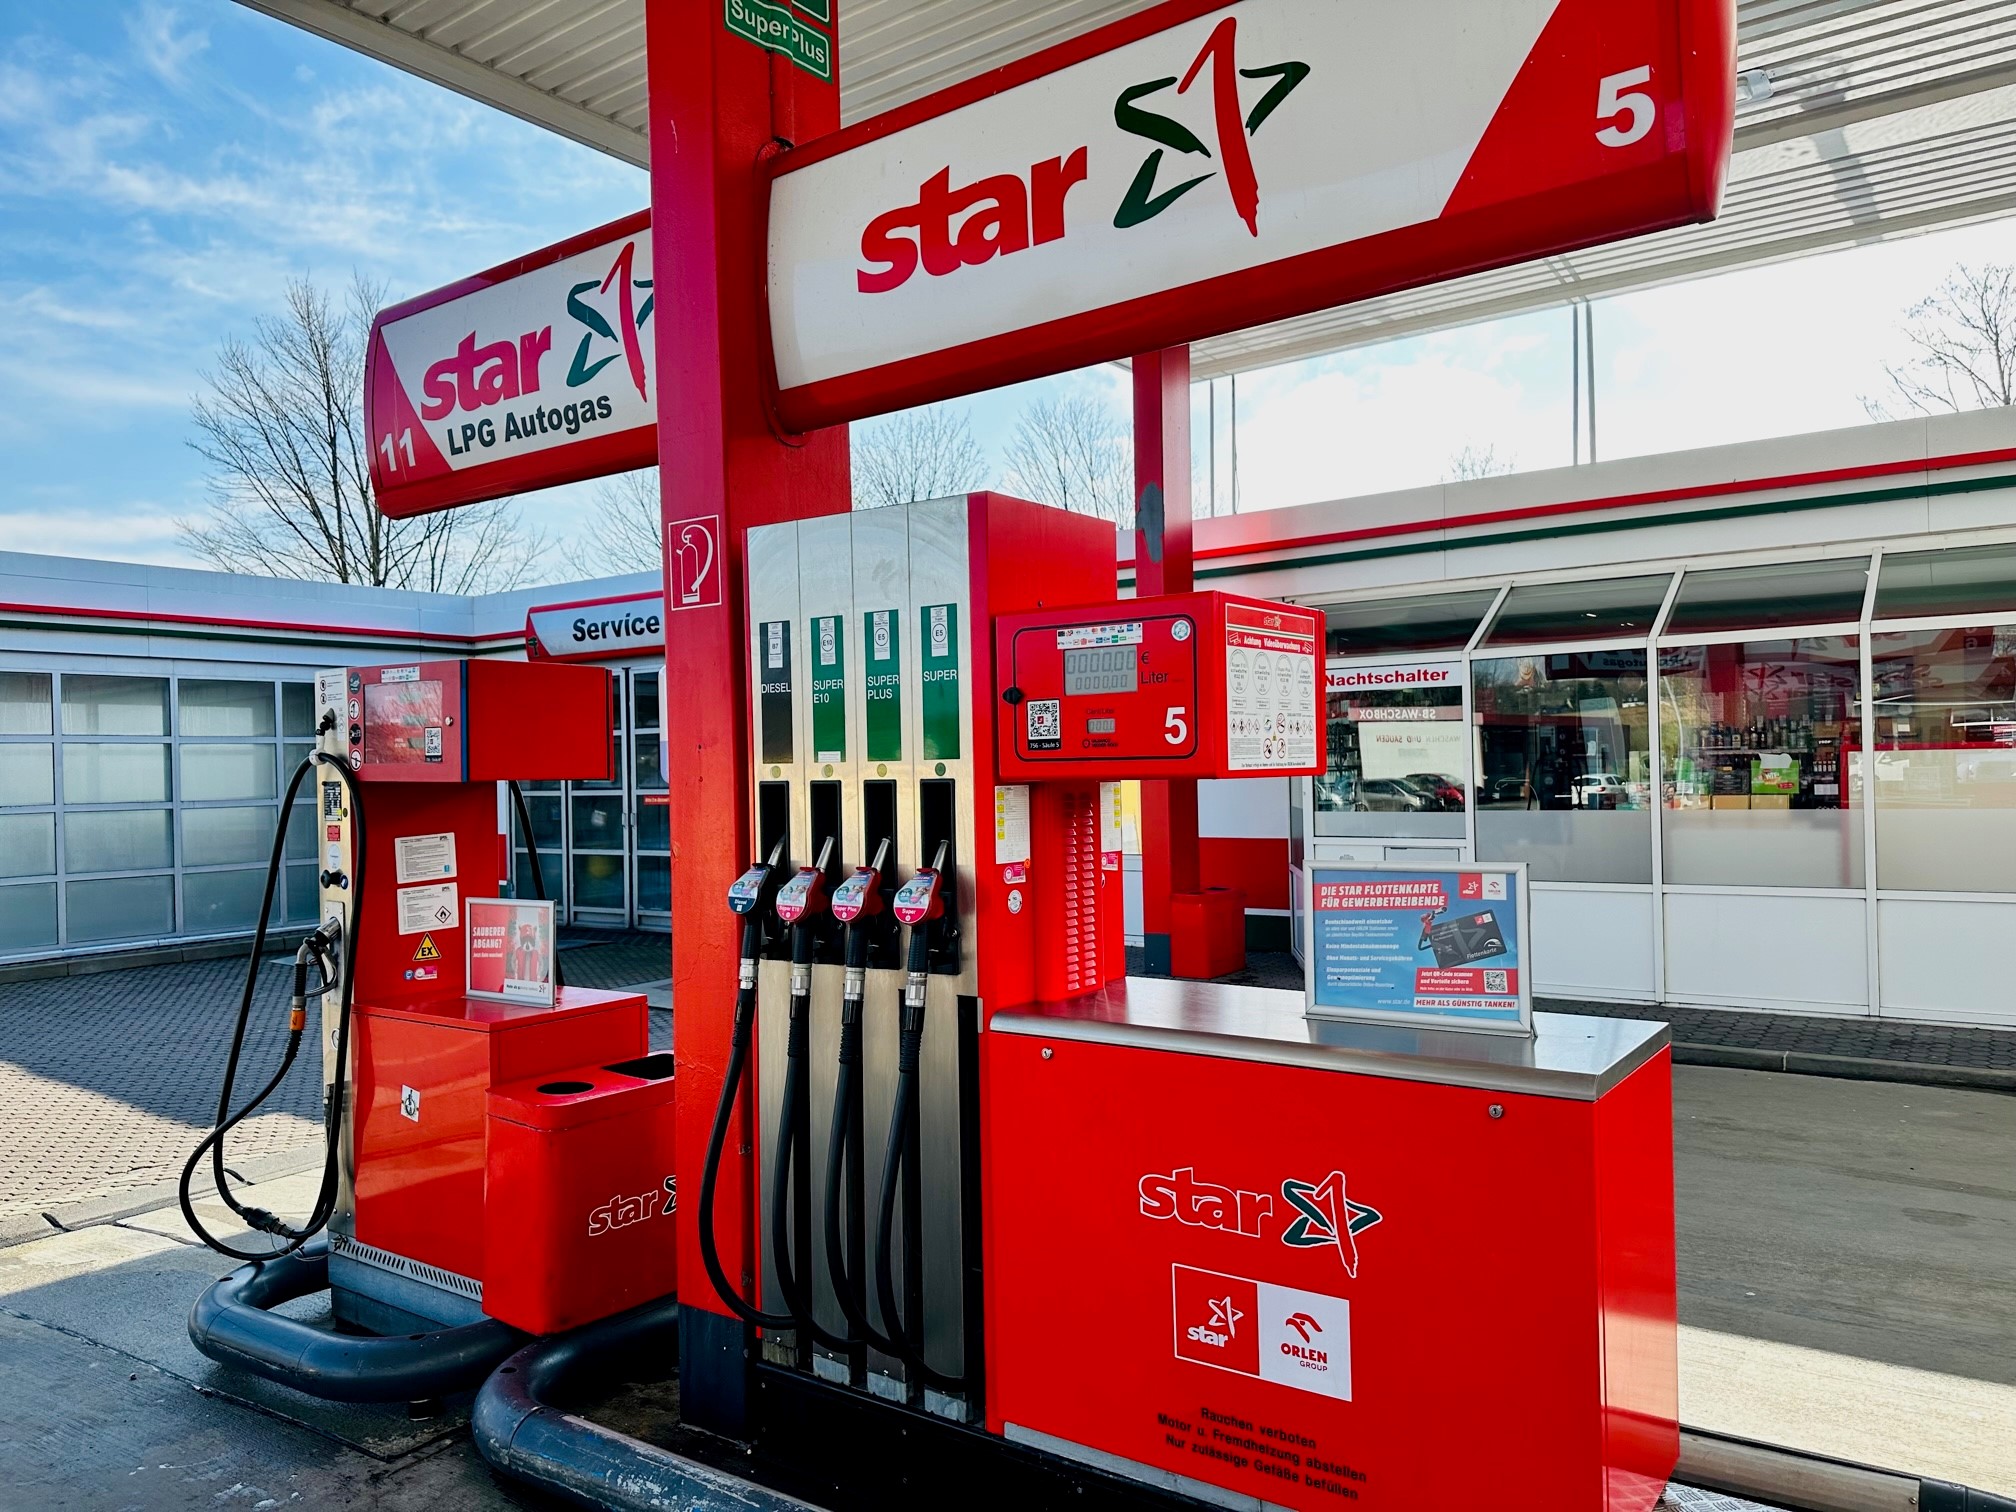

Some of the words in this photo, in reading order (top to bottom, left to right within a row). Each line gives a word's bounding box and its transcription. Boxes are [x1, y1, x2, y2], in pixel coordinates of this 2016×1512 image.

[1595, 64, 1656, 148] 5
[857, 145, 1088, 294] star
[421, 325, 552, 421] star
[447, 418, 496, 456] LPG
[505, 395, 613, 442] Autogas
[381, 428, 416, 472] 11
[572, 613, 660, 642] Service
[935, 629, 944, 637] E5
[822, 639, 833, 647] E10
[877, 633, 886, 641] E5
[867, 675, 900, 687] SUPER
[923, 669, 957, 682] SUPER
[1141, 671, 1169, 684] Liter
[1326, 669, 1449, 687] Nachtschalter
[761, 682, 791, 694] DIESEL
[813, 679, 844, 691] SUPER
[814, 693, 830, 704] E10
[867, 689, 893, 700] PLUS
[1164, 706, 1188, 745] 5
[1321, 886, 1337, 896] DIE
[1338, 885, 1363, 895] STAR
[1364, 883, 1439, 895] FLOTTENKARTE
[1321, 897, 1339, 908] FÜR
[1342, 896, 1445, 908] GEWERBETREIBENDE
[473, 927, 506, 936] SAUBERER
[473, 939, 502, 948] ABGANG?
[421, 947, 433, 957] EX
[1466, 947, 1497, 959] Flottenkarte
[1451, 998, 1482, 1007] GÜNSTIG
[1139, 1167, 1273, 1238] star
[589, 1190, 659, 1236] star
[1187, 1325, 1229, 1348] star
[1280, 1342, 1328, 1364] ORLEN
[1299, 1360, 1328, 1372] GROUP
[1201, 1407, 1253, 1432] Rauchen
[1260, 1424, 1317, 1449] verboten
[1158, 1413, 1191, 1432] Motor
[1213, 1428, 1300, 1466] Fremdheizung
[1306, 1456, 1367, 1483] abstellen
[1166, 1434, 1186, 1448] Nur
[1191, 1441, 1248, 1468] zulässige
[1254, 1459, 1299, 1482] Gefäße
[1306, 1474, 1358, 1500] befüllen
